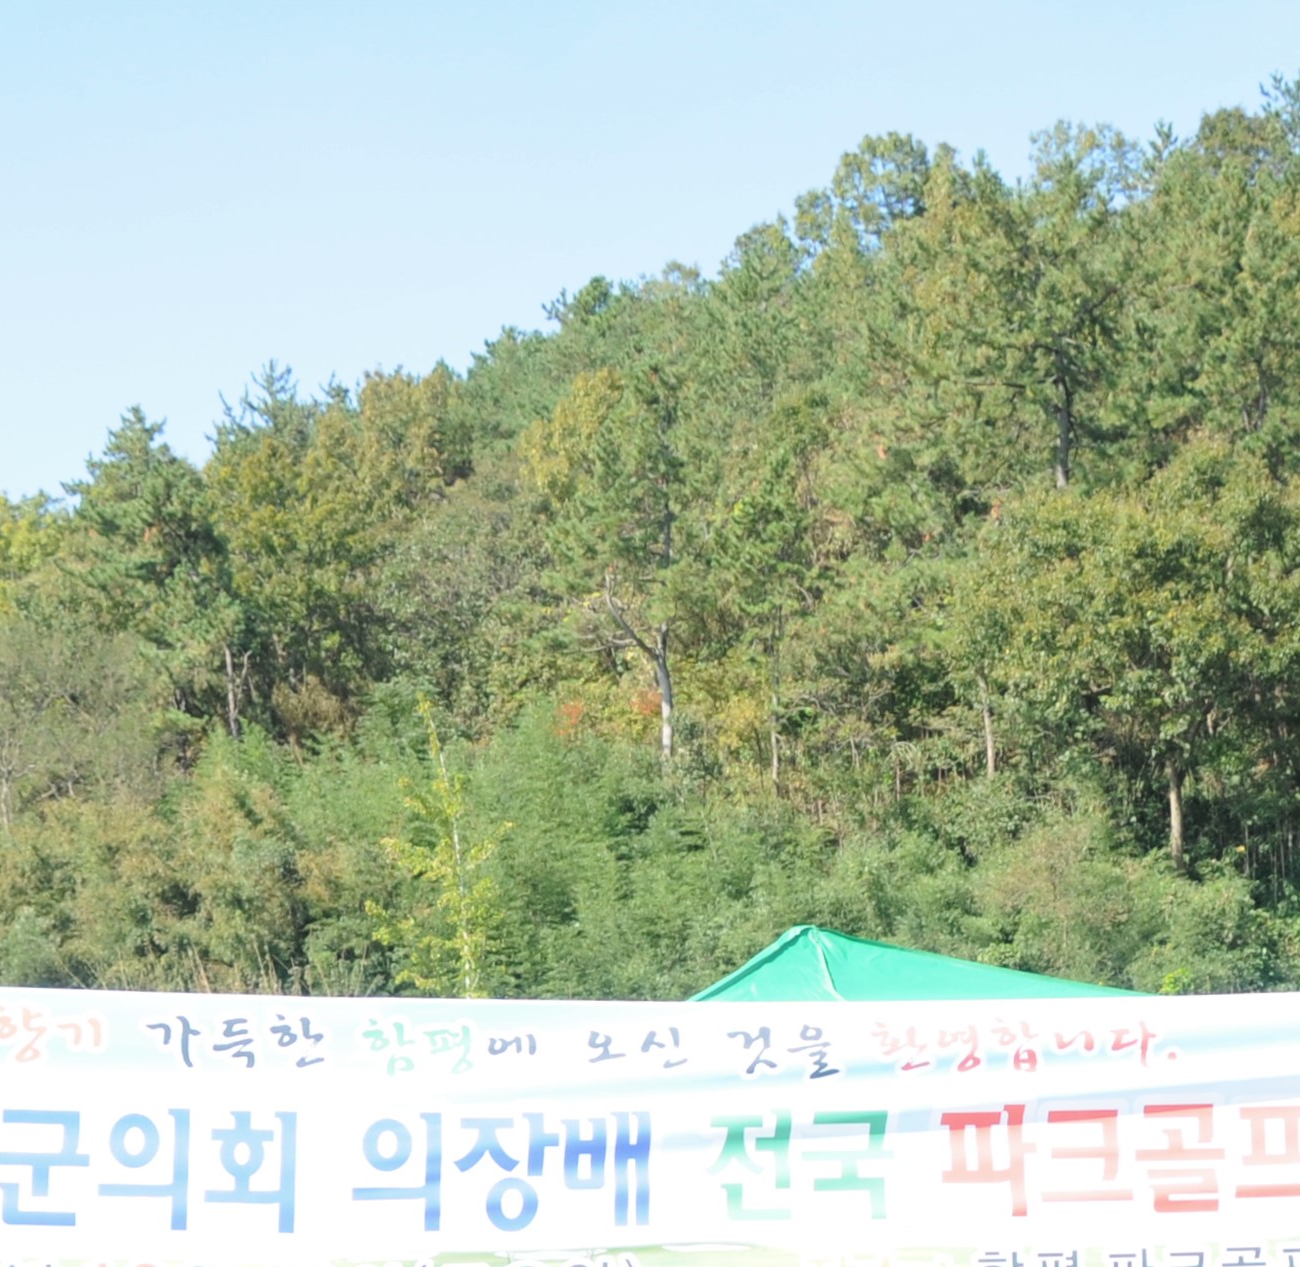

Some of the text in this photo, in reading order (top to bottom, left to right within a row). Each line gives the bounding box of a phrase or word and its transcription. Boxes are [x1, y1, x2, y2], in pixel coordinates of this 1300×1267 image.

[146, 1013, 325, 1069] 가득한
[361, 1016, 537, 1077] 함평에
[588, 1026, 688, 1069] 오신
[727, 1024, 841, 1080] 것을
[870, 1017, 1179, 1074] 환영합니다.
[351, 1111, 652, 1232] 의장배
[707, 1109, 893, 1220] 전국
